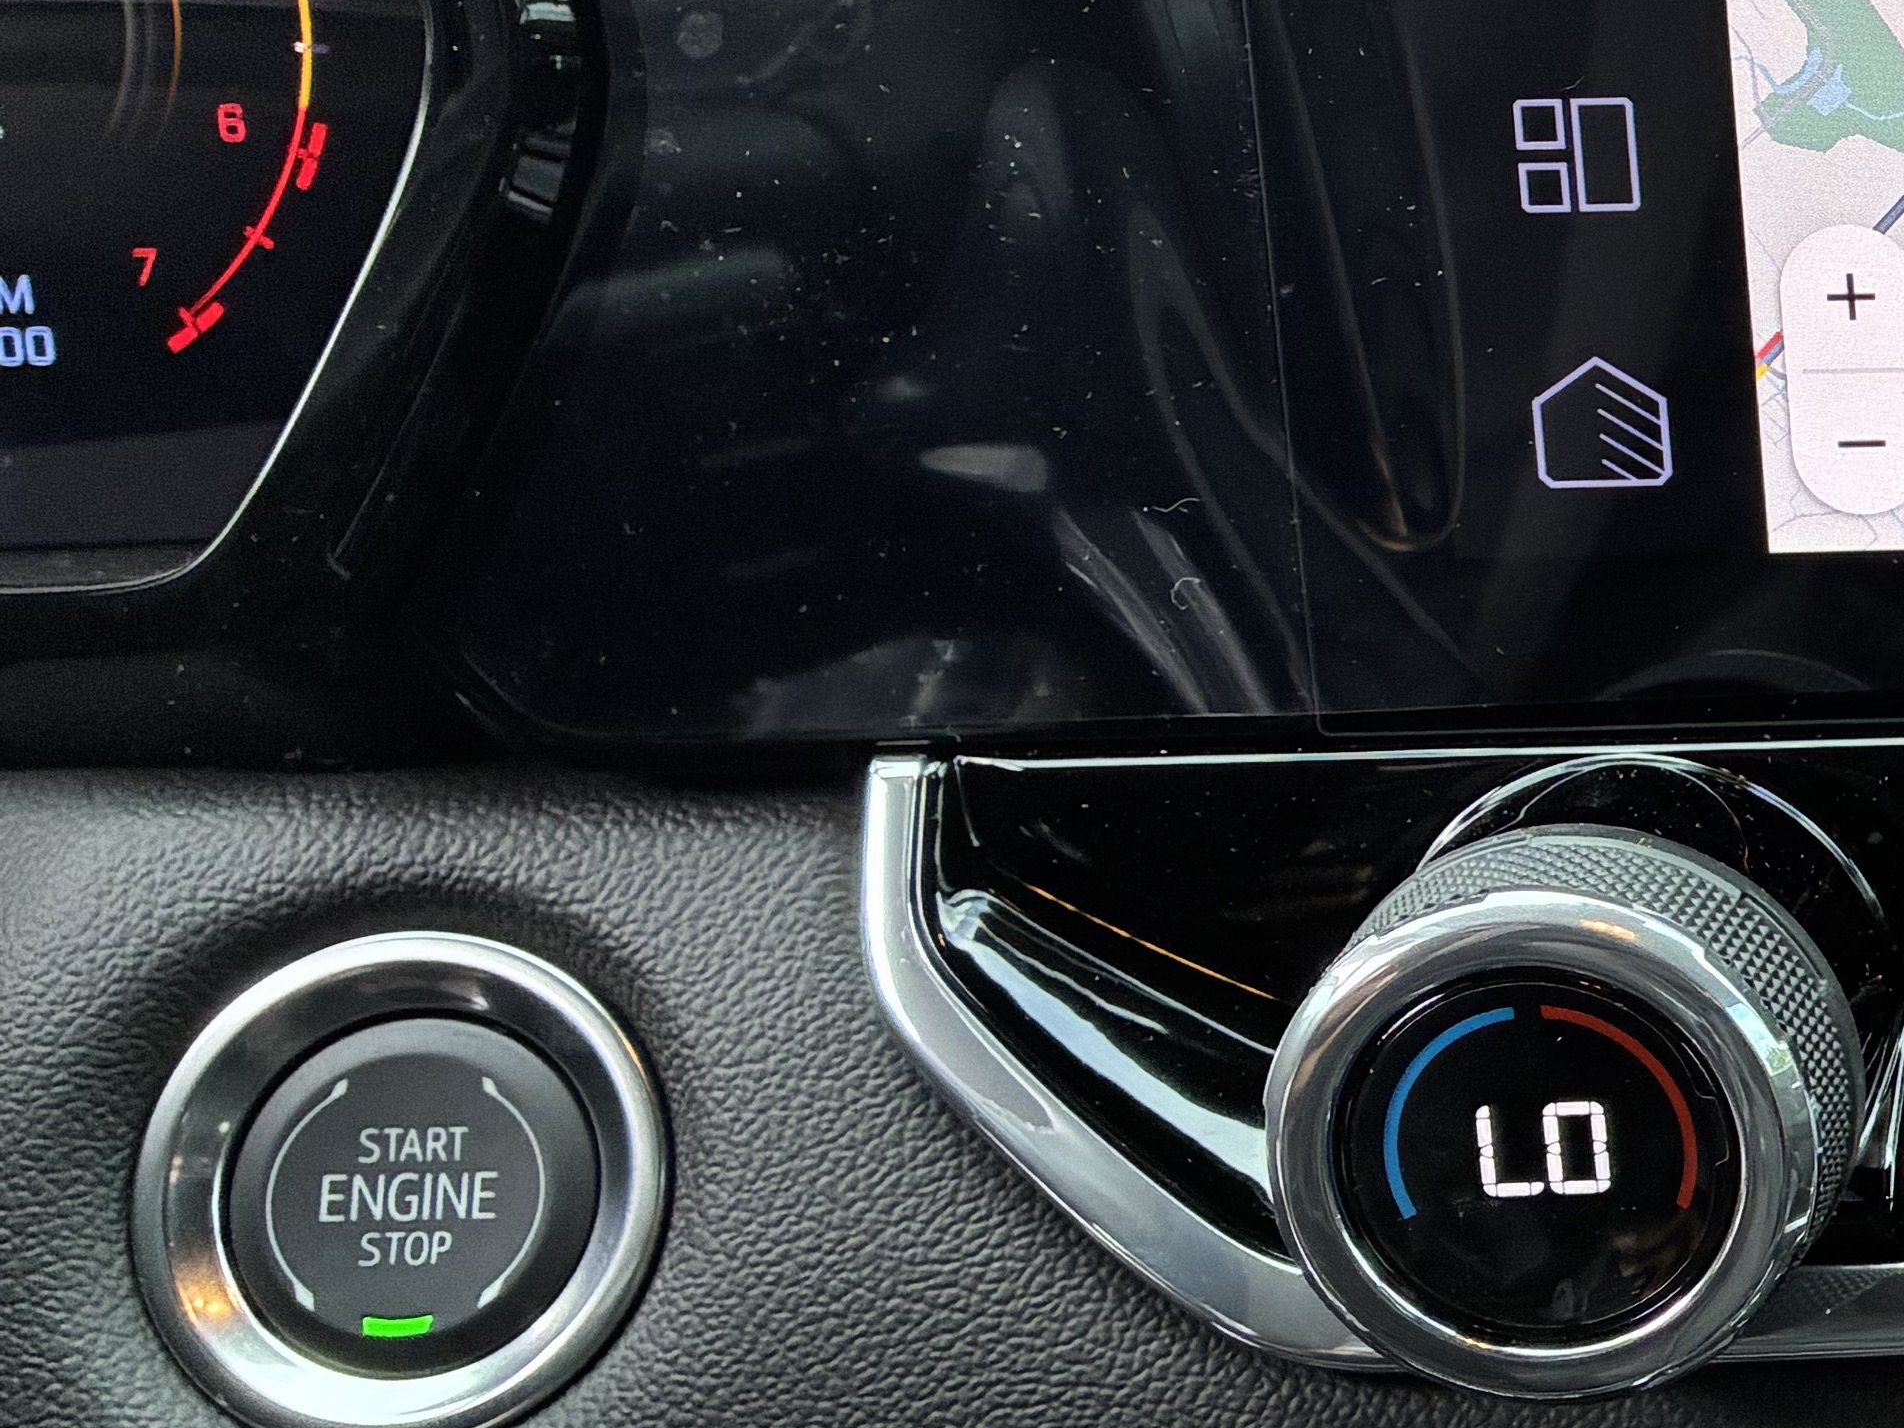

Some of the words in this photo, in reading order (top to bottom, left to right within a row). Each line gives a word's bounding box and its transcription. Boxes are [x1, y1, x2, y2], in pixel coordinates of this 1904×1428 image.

[217, 104, 246, 141] 6
[131, 248, 158, 285] 7
[358, 1126, 469, 1165] START
[318, 1171, 499, 1223] ENGINE
[358, 1230, 453, 1268] STOP
